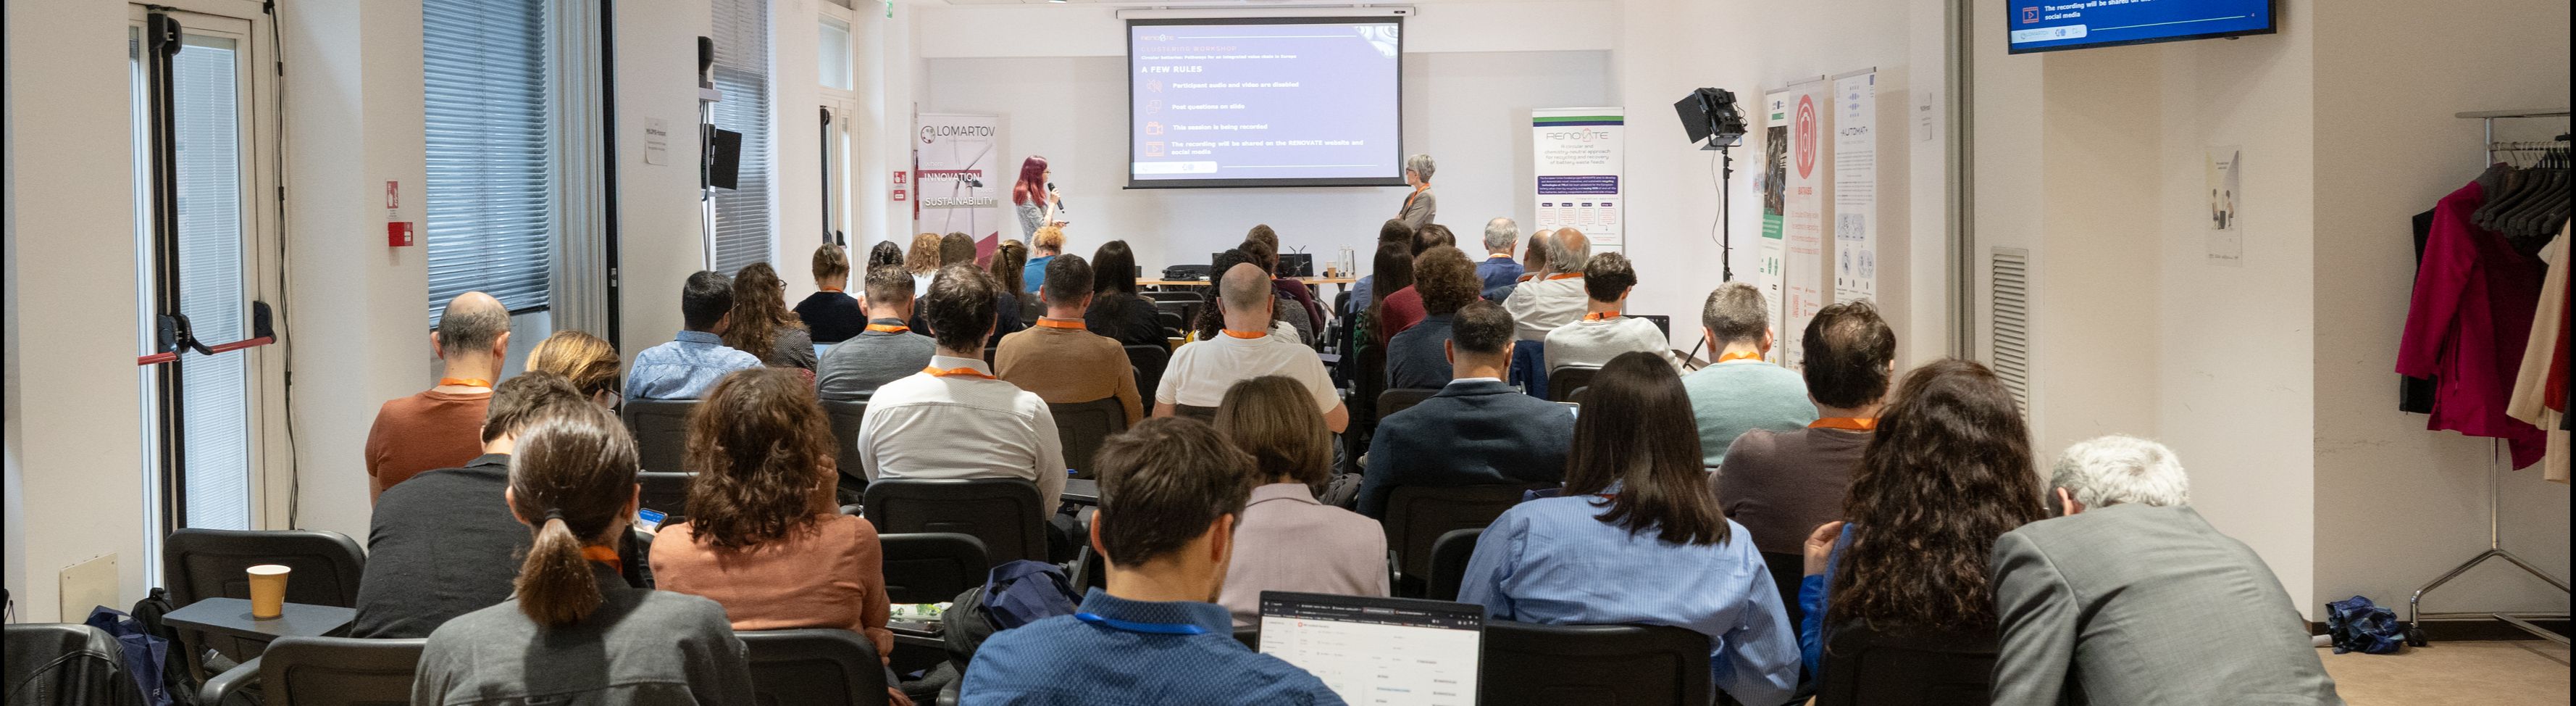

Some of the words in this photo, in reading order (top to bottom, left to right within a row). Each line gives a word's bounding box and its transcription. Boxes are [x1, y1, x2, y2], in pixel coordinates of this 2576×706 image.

[937, 125, 995, 137] LOMARTOV
[924, 173, 979, 181] INNOVATION
[925, 196, 993, 206] SUSTAINABILITY
